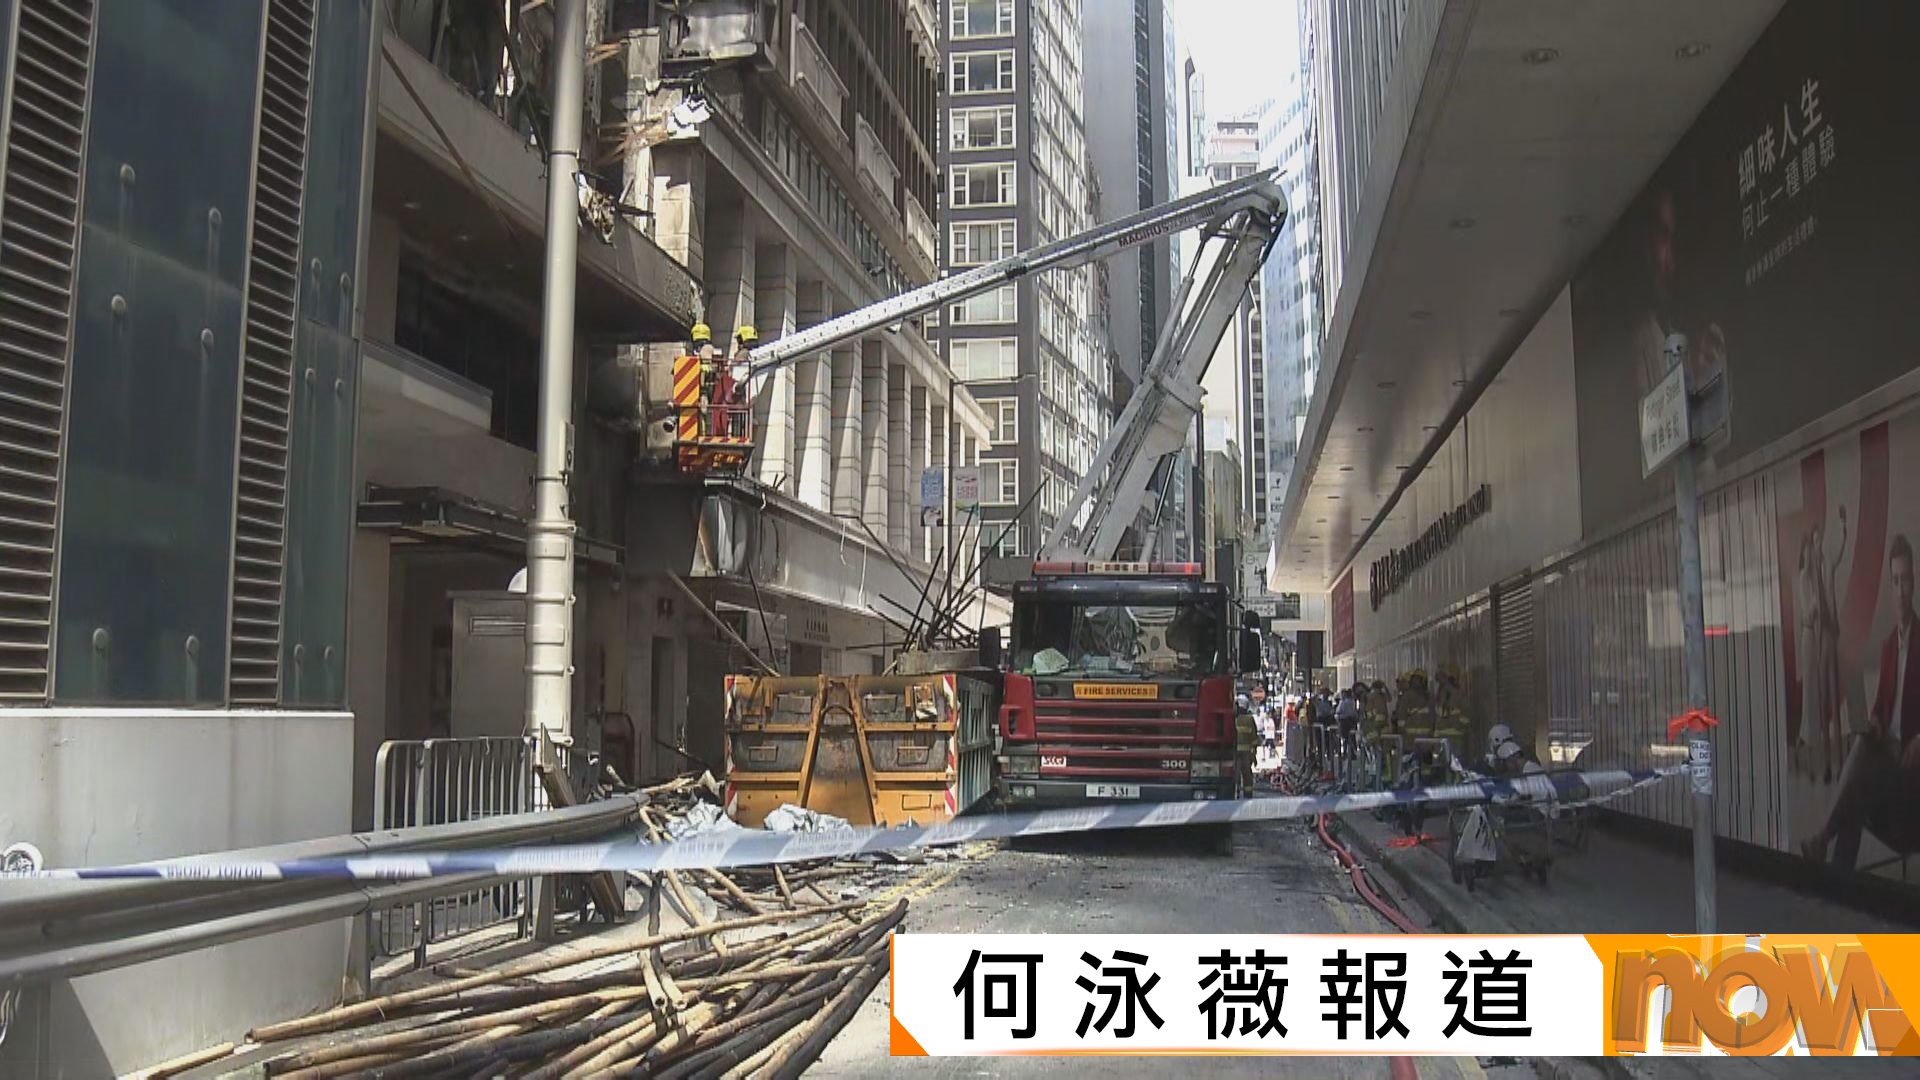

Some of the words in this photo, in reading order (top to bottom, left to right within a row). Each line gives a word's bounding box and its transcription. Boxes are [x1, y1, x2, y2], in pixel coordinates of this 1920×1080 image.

[1738, 78, 1822, 200] 細味人生
[1742, 124, 1835, 240] 何止一種體驗
[1083, 685, 1103, 695] FIRE
[1105, 685, 1151, 695] SERVICES
[1161, 759, 1187, 769] 300
